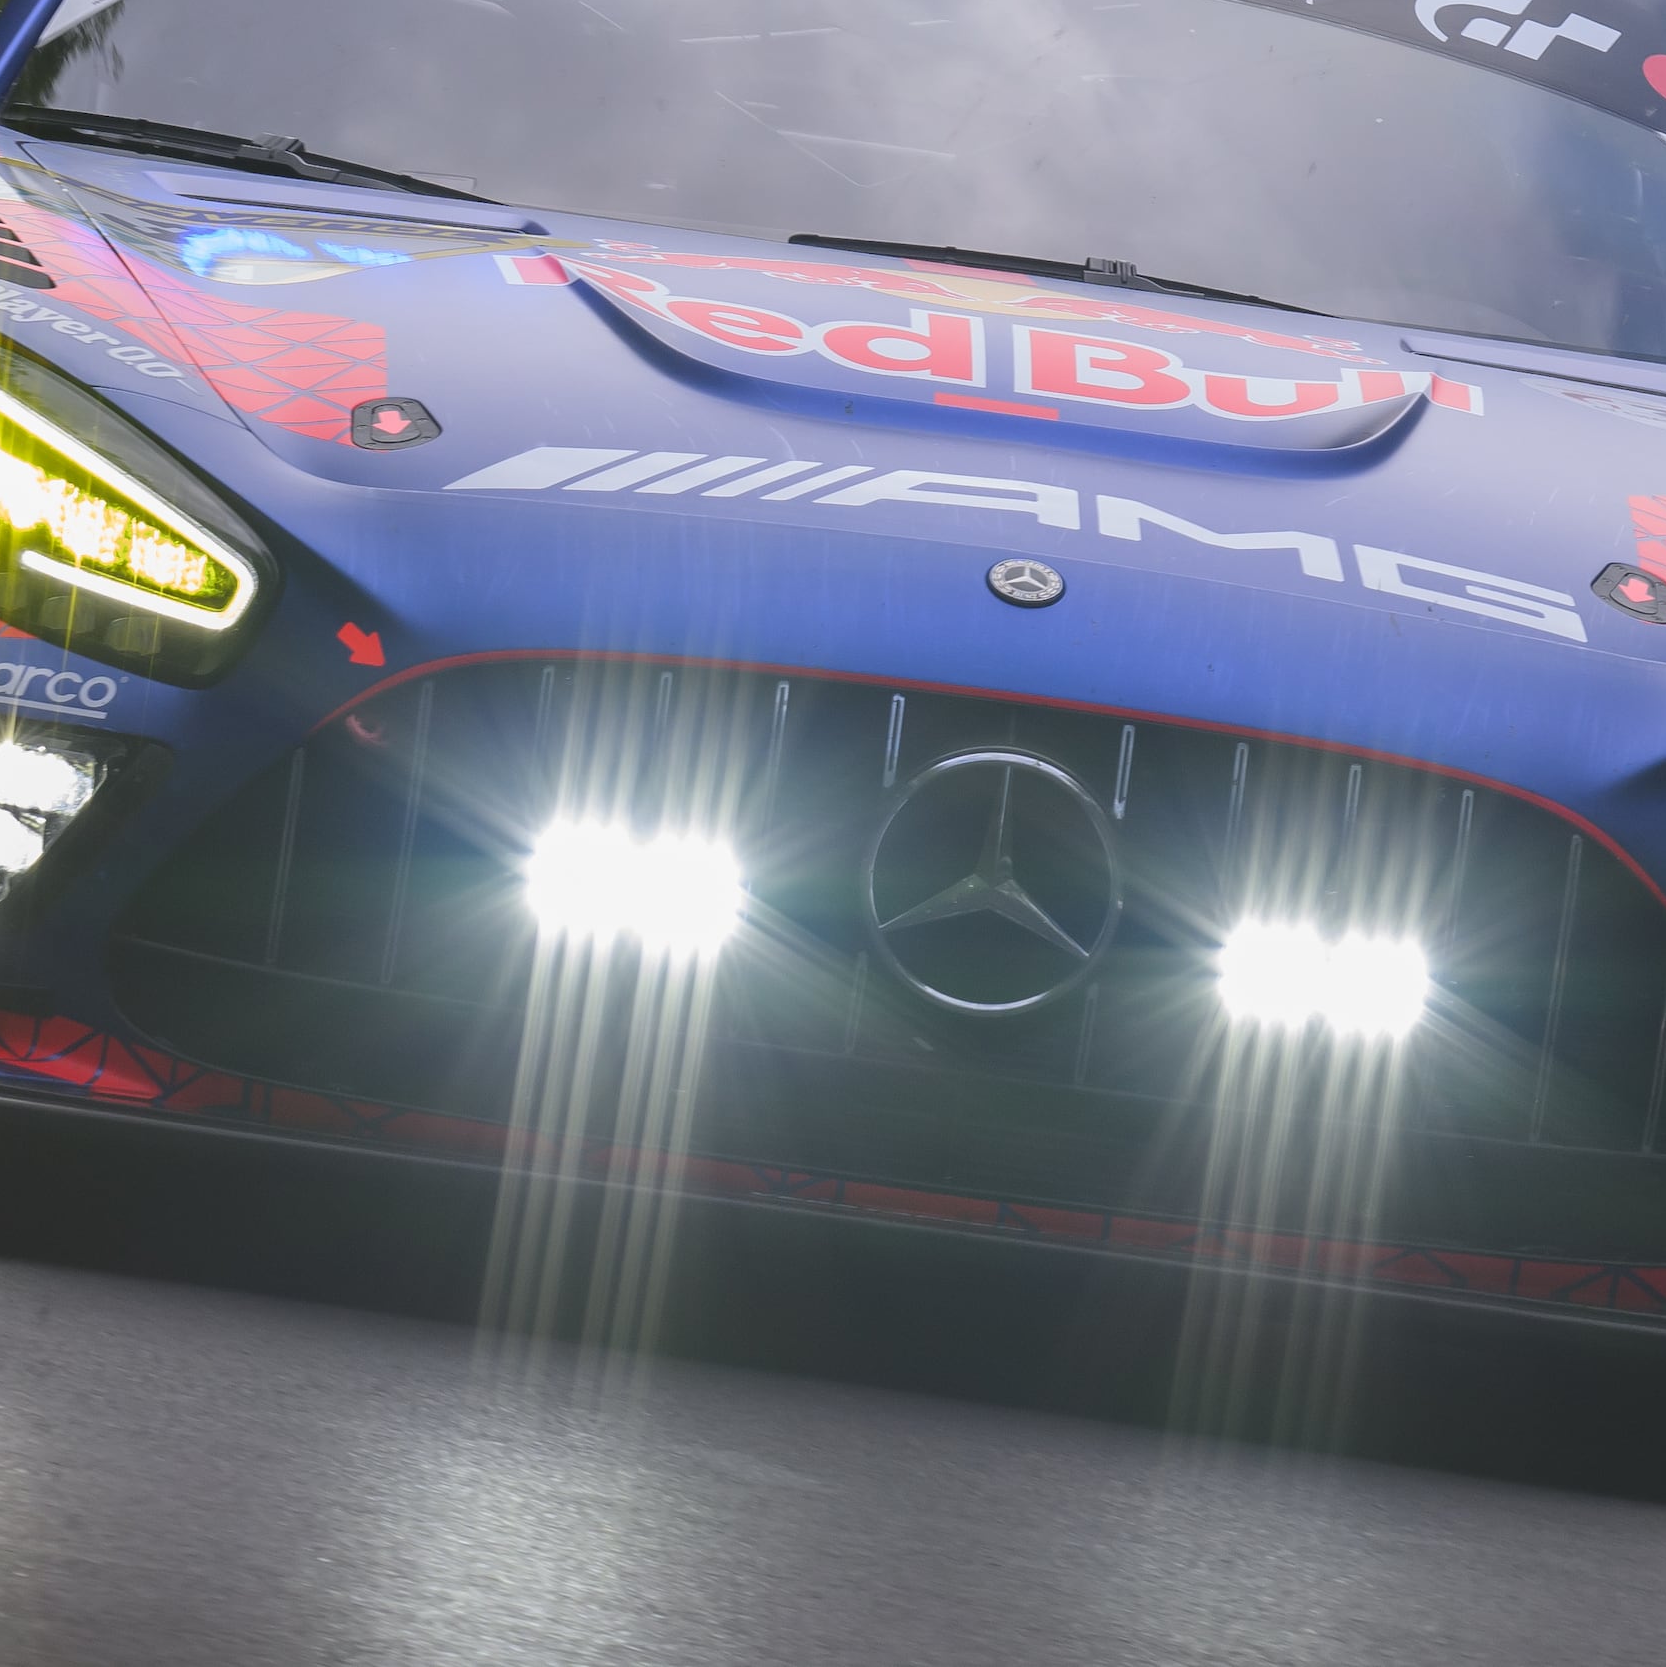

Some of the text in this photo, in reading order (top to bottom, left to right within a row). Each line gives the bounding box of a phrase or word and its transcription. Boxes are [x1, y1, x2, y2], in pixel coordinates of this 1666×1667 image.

[493, 253, 1484, 422] Red Bull
[812, 469, 1589, 644] AMG
